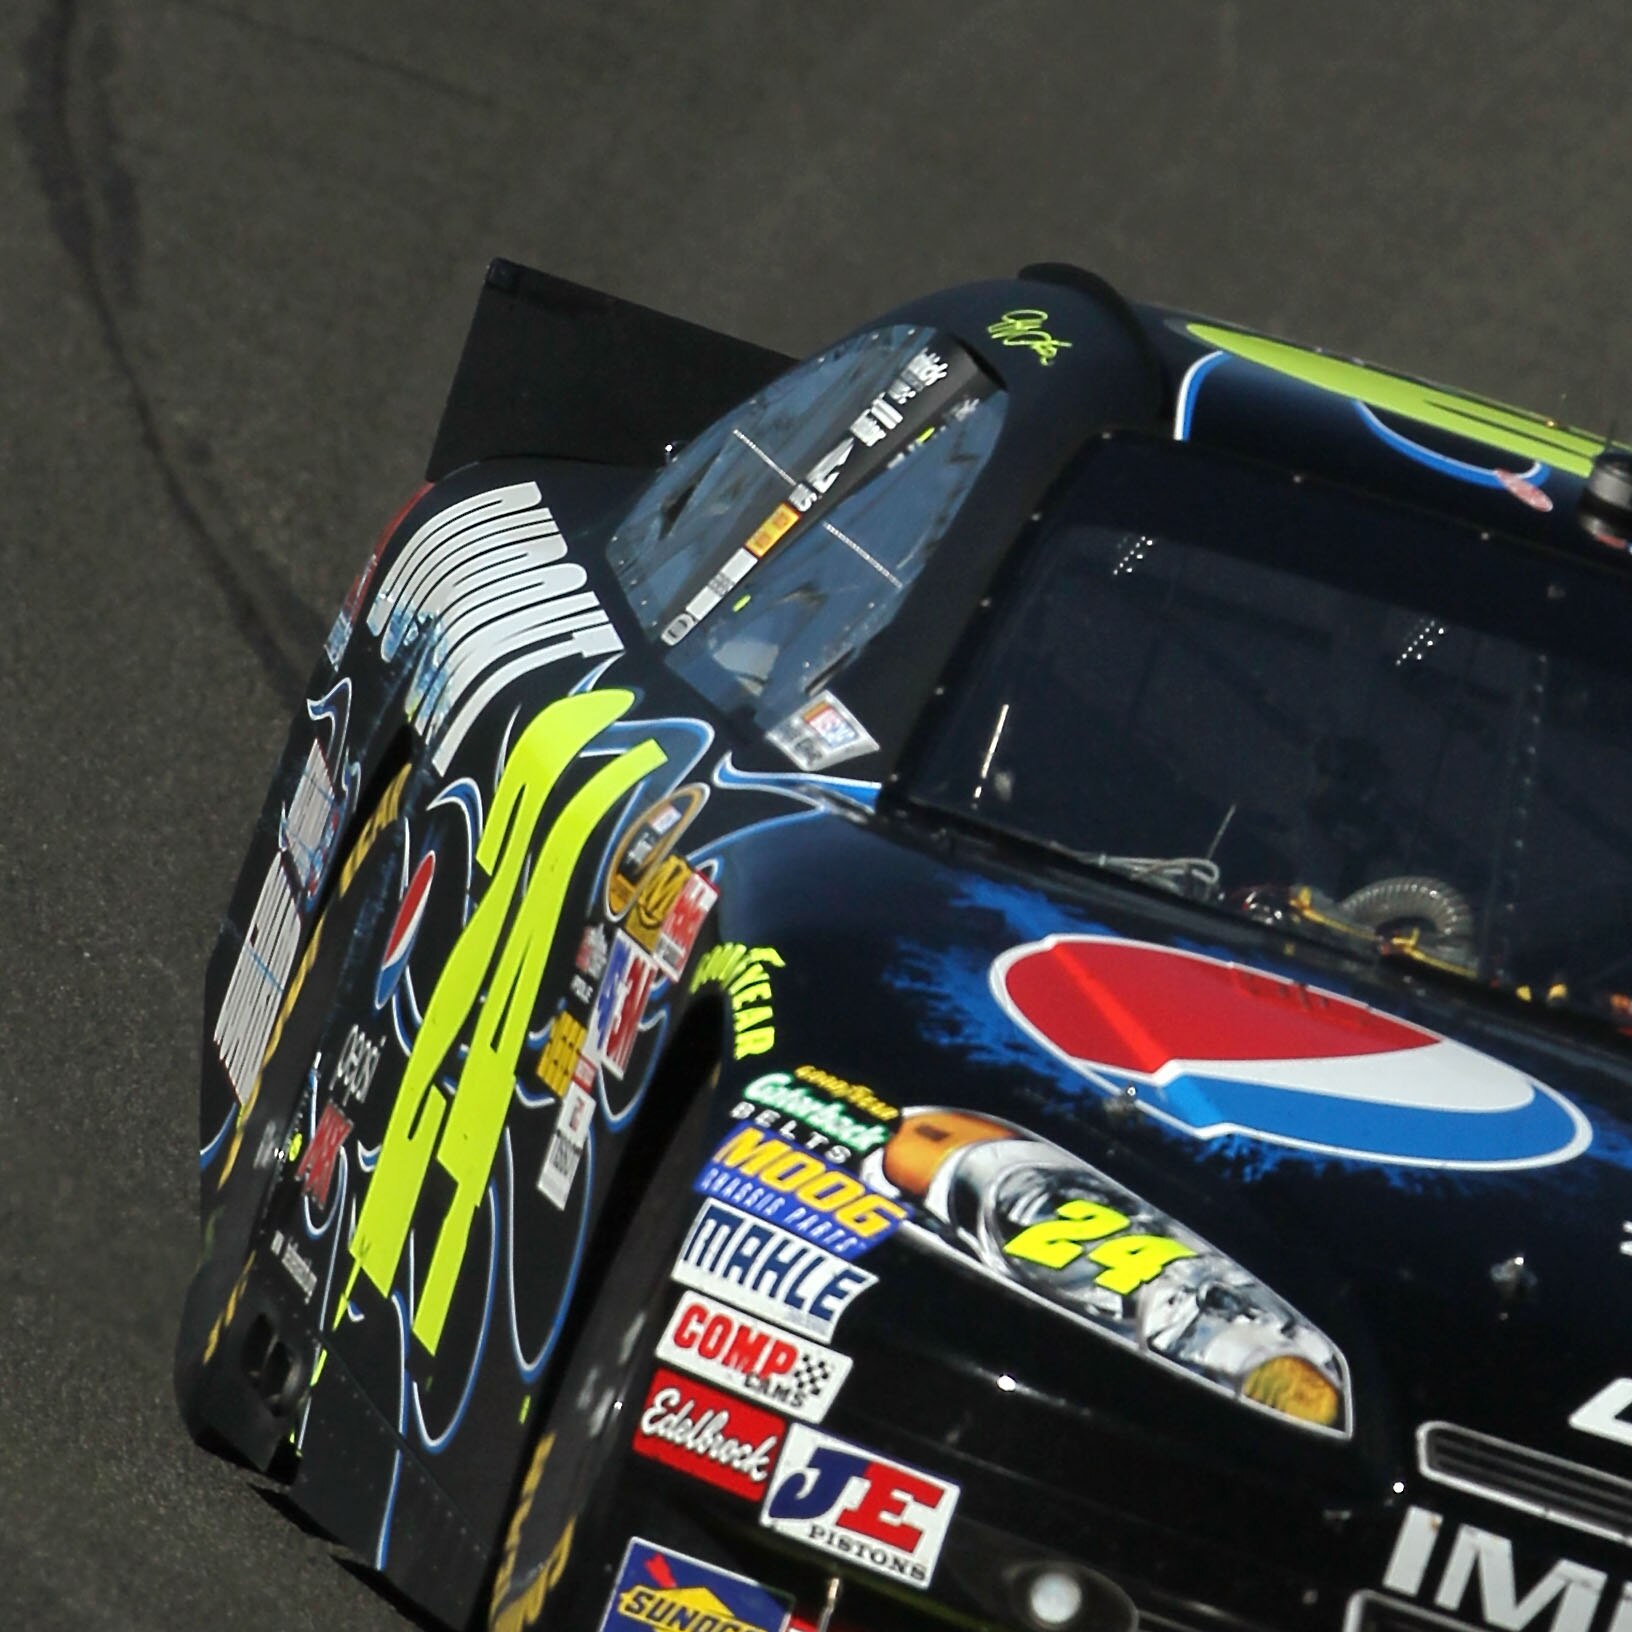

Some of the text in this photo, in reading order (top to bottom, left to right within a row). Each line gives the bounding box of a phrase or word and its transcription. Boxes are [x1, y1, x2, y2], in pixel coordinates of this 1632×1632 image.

[729, 1101, 852, 1165] BELTS
[700, 1167, 858, 1253] CHASSIS PARTS
[711, 1126, 907, 1239] MOOG
[683, 1204, 865, 1322] MAHLE
[1003, 1200, 1198, 1296] 24
[672, 1303, 800, 1380] COMP
[640, 1388, 777, 1483] Edelbrock
[742, 1372, 807, 1409] CAMS
[768, 1445, 945, 1554] JE
[809, 1524, 927, 1582] PISTONS
